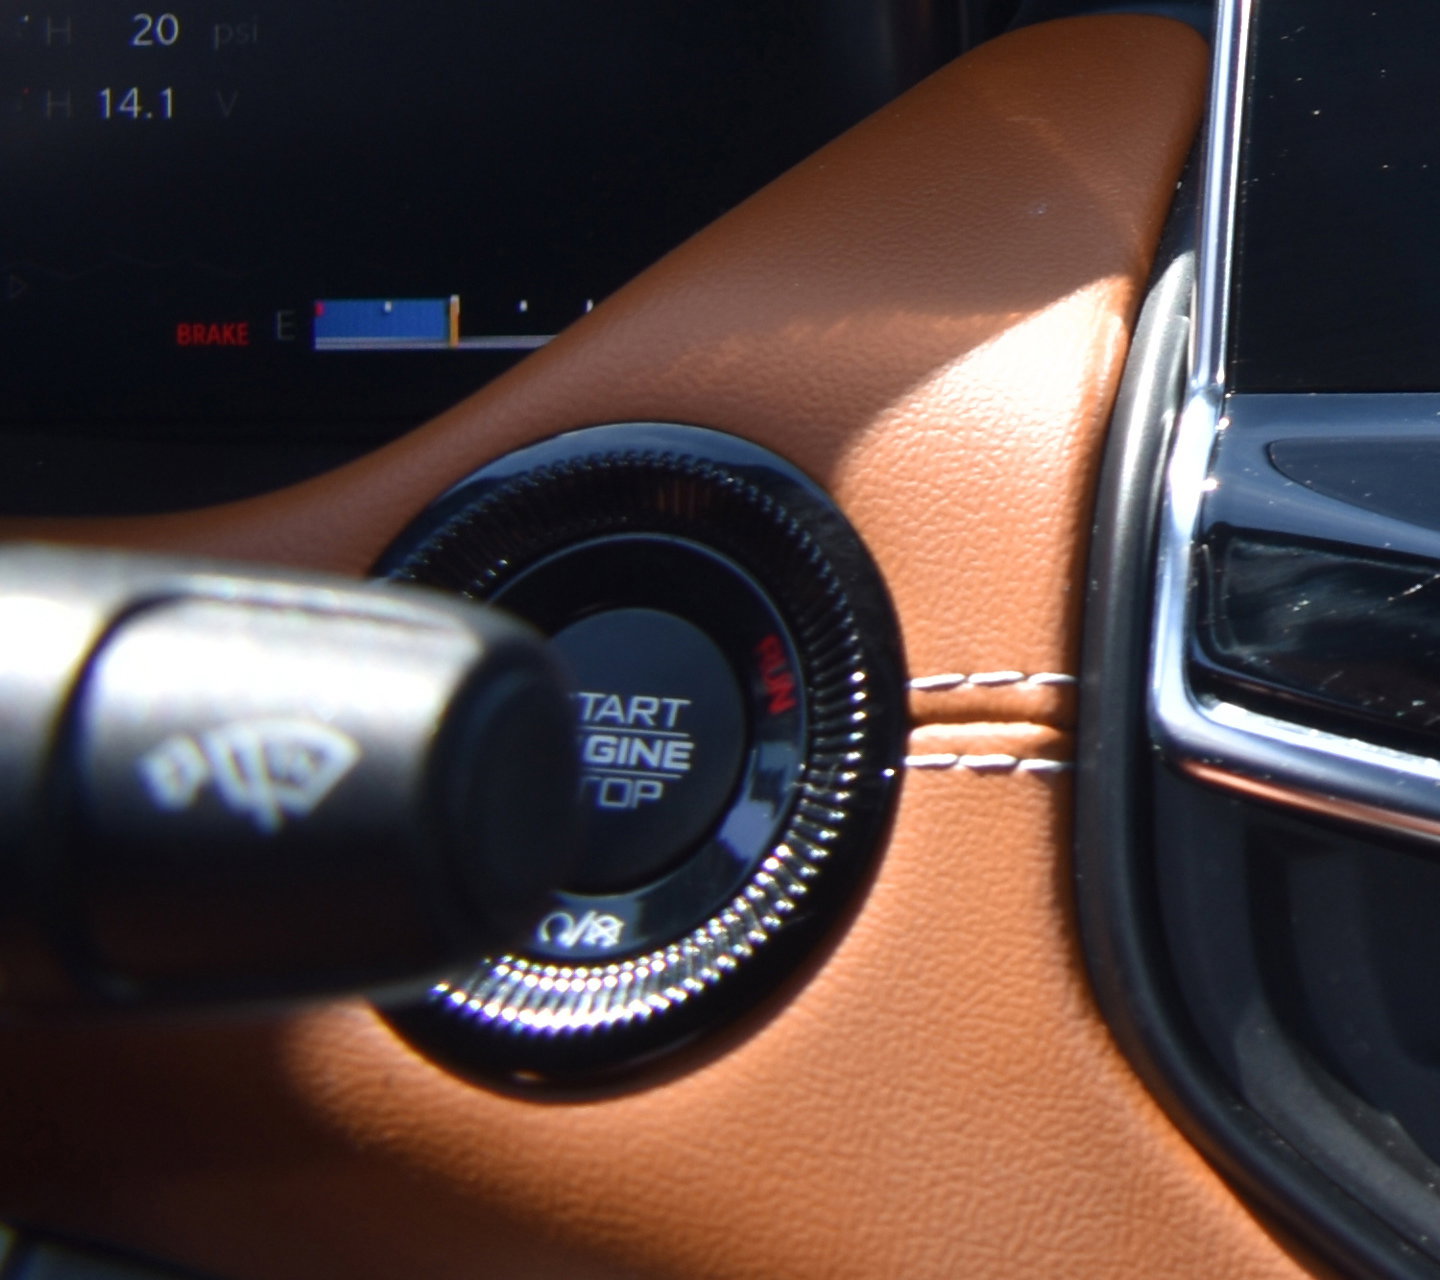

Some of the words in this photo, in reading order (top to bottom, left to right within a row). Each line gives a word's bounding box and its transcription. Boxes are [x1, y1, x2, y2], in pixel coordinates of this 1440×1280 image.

[129, 13, 179, 47] 20
[98, 87, 172, 119] 14.1
[176, 322, 248, 346] BRAKE
[576, 691, 691, 728] TART
[581, 733, 695, 772] GINE
